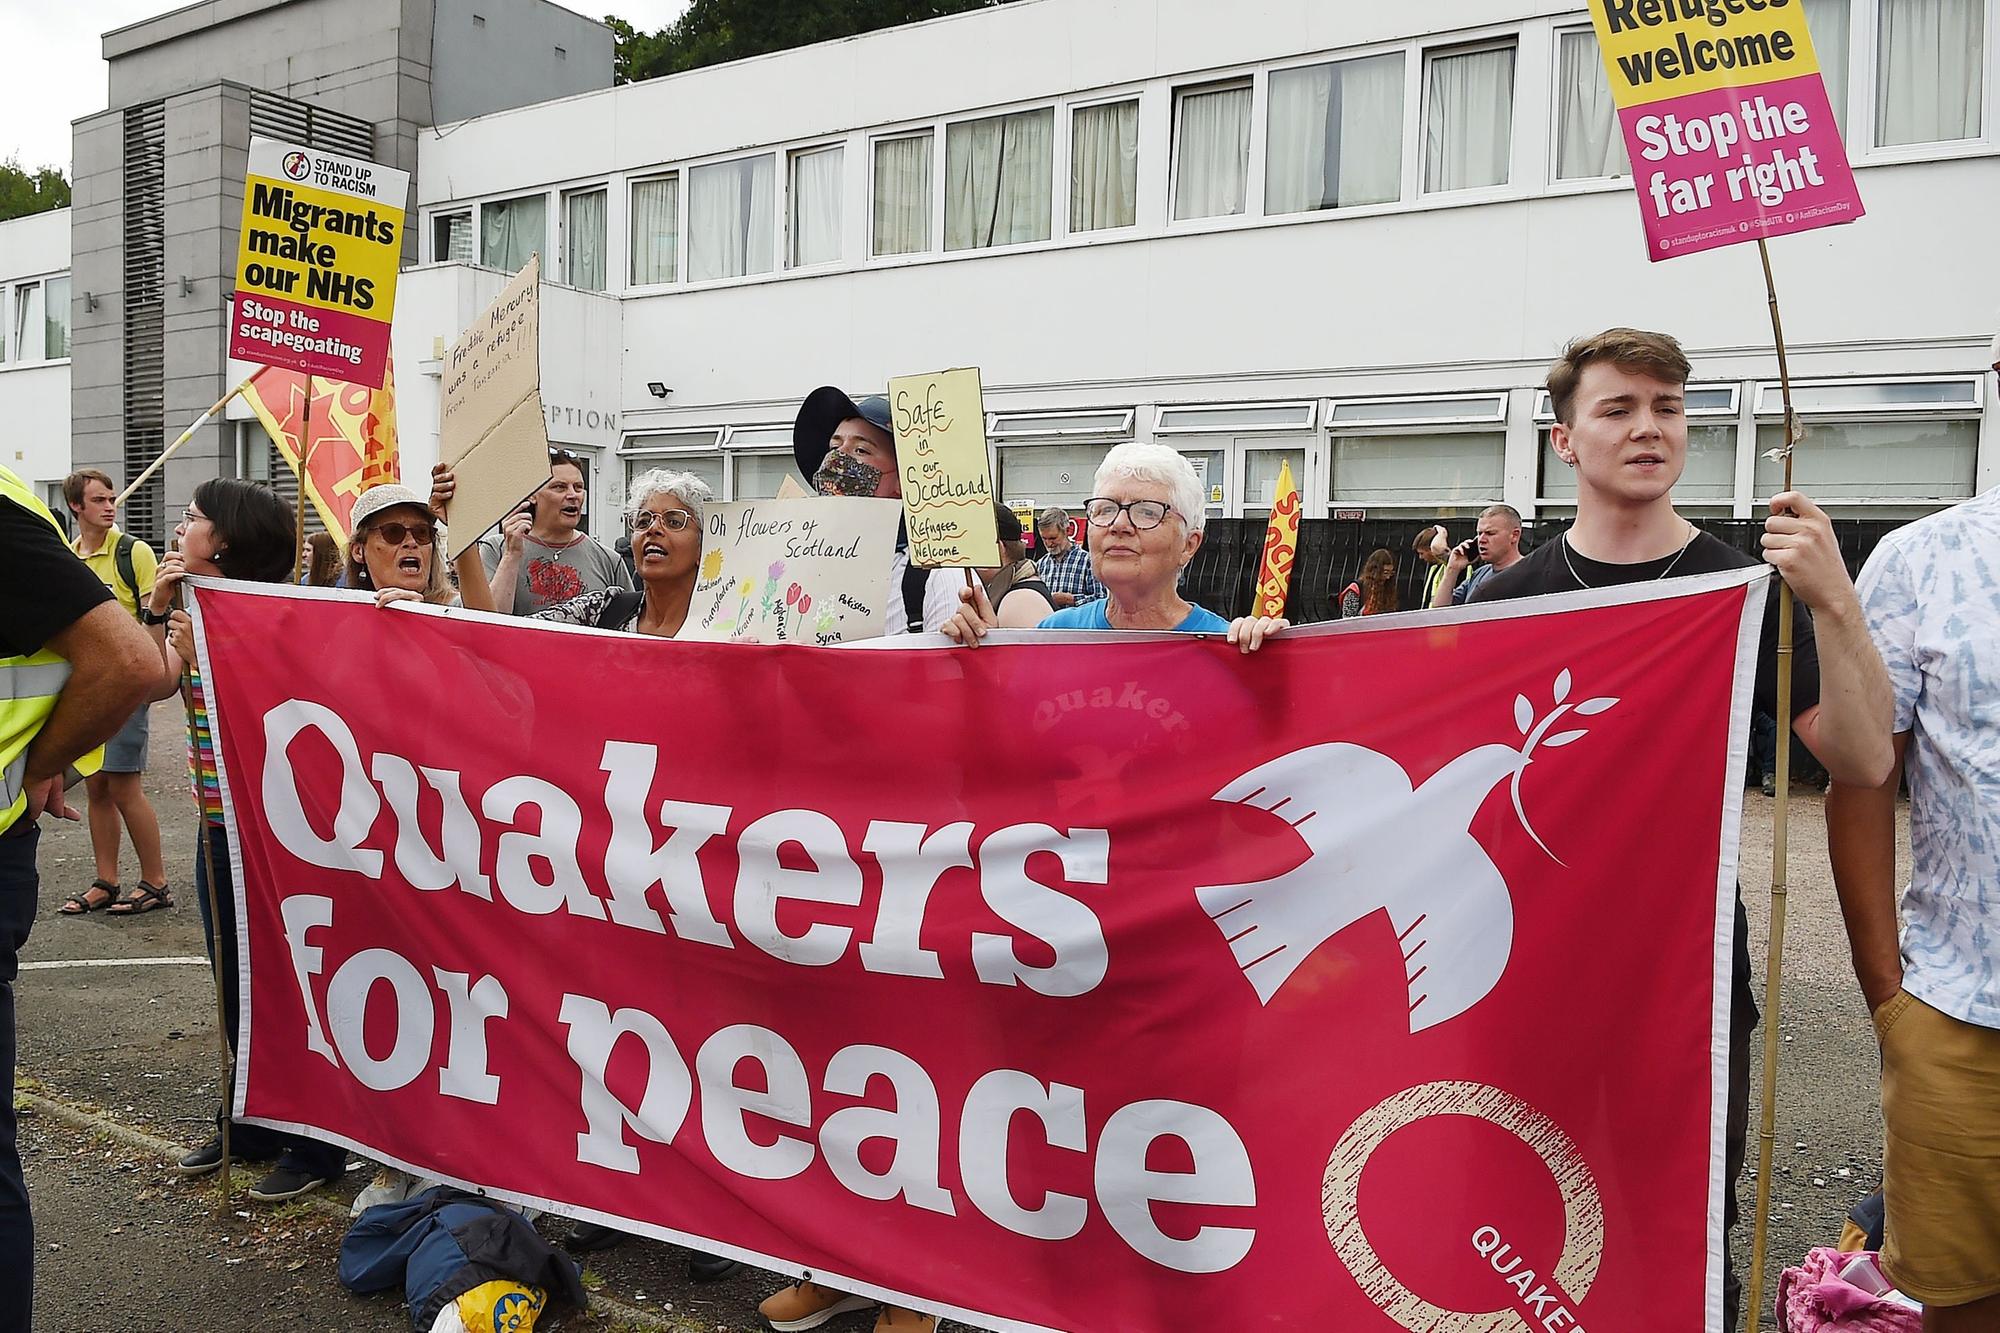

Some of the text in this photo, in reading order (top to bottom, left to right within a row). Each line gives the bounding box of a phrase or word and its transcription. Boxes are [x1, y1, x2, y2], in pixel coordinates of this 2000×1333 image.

[1603, 0, 1789, 34] Refug
[1617, 30, 1796, 86] welcome
[1636, 96, 1811, 161] Stop the
[314, 172, 377, 197] TO RACISM
[315, 158, 372, 182] STAND UP
[1649, 146, 1825, 218] far right
[252, 183, 395, 245] Migrants
[248, 228, 336, 268] make
[245, 263, 375, 310] our NHS
[490, 284, 534, 329] Mercury
[241, 300, 320, 332] Stop the
[239, 323, 363, 364] scapegoating
[448, 312, 525, 395] was a refugee
[896, 383, 946, 436] Safe
[918, 434, 929, 450] in
[906, 466, 989, 507] Scotland
[922, 461, 939, 473] our
[709, 507, 819, 546] Oh flowers of
[784, 535, 861, 559] Scotland
[838, 593, 872, 617] Pakistan
[815, 631, 843, 647] Syria
[262, 698, 1110, 998] Quakers
[280, 894, 1257, 1274] for peace
[1471, 1225, 1588, 1333] QUAKE
